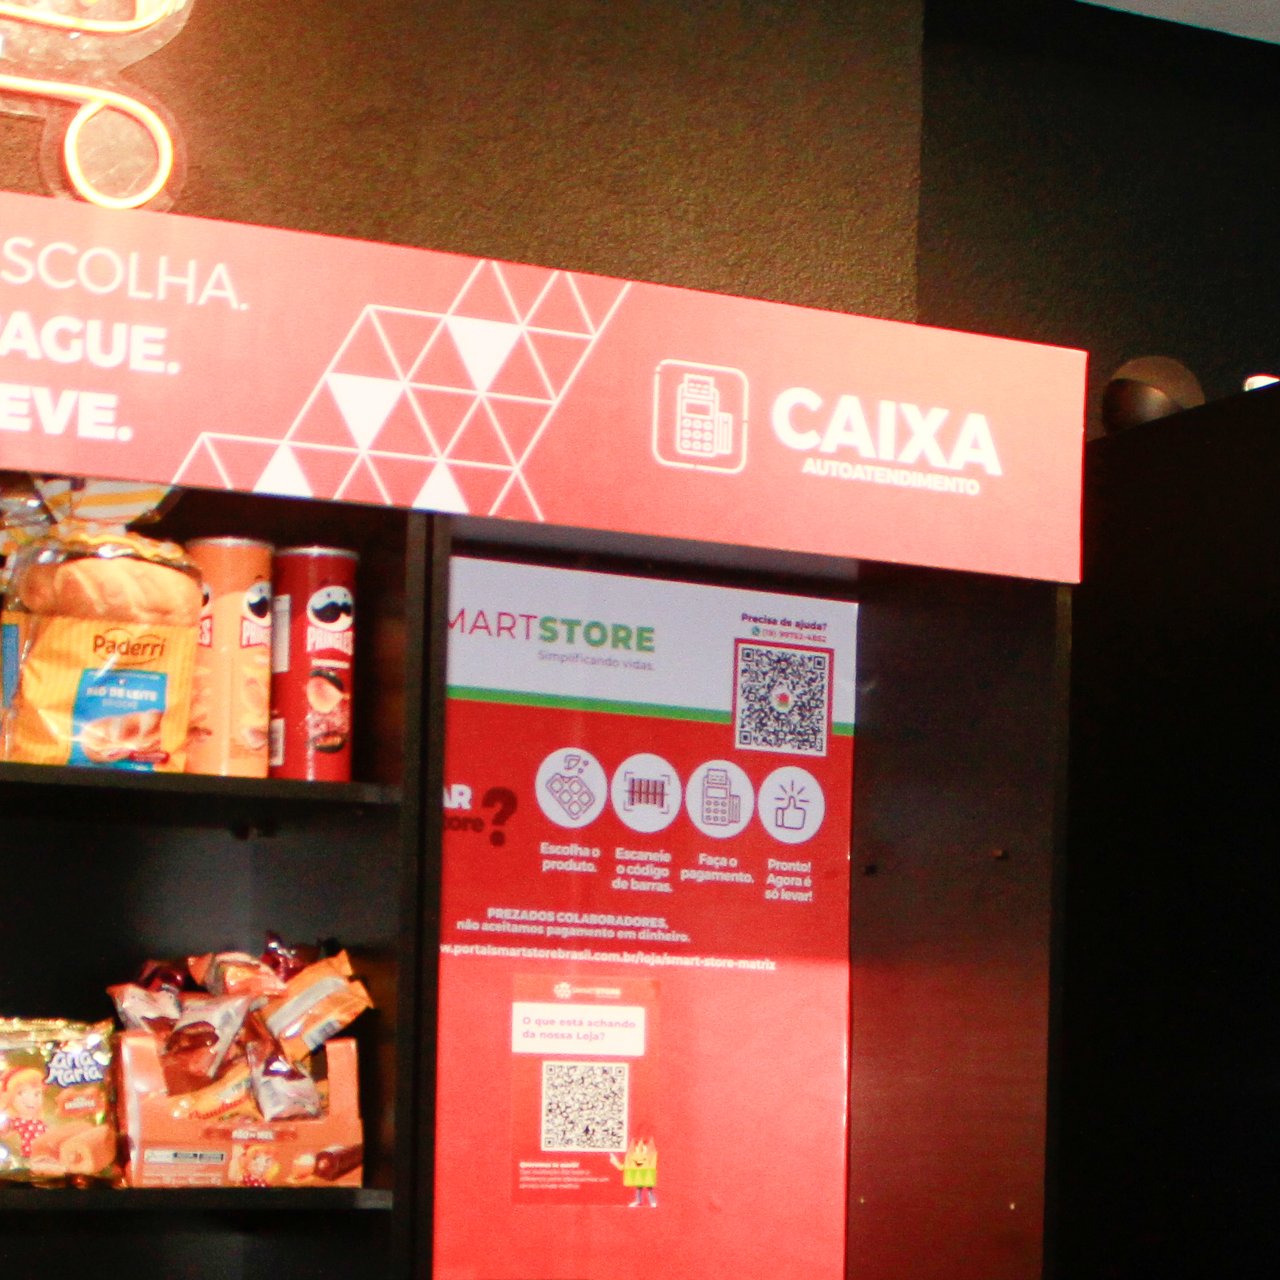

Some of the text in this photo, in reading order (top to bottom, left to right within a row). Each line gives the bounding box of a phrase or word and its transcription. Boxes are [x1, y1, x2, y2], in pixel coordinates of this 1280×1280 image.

[771, 385, 1004, 477] CAIXA
[802, 457, 981, 496] AUTOATENDIMENTO
[537, 648, 621, 669] Simplificando
[539, 842, 591, 857] Escolha
[614, 847, 672, 864] Escaneie
[698, 852, 727, 870] Faça
[767, 857, 812, 873] Pronto!
[627, 863, 670, 881] código
[612, 877, 627, 889] de
[766, 874, 801, 889] Agora
[765, 887, 813, 902] só levar!
[486, 907, 555, 922] PREZADOS
[456, 918, 480, 931] não
[481, 920, 545, 935] aceitamos
[546, 924, 616, 940] pagamento
[617, 928, 637, 939] em
[522, 1016, 531, 1025] O
[534, 1018, 556, 1028] que
[587, 1019, 636, 1029] achando
[522, 1030, 536, 1039] da
[539, 1031, 573, 1040] nossa
